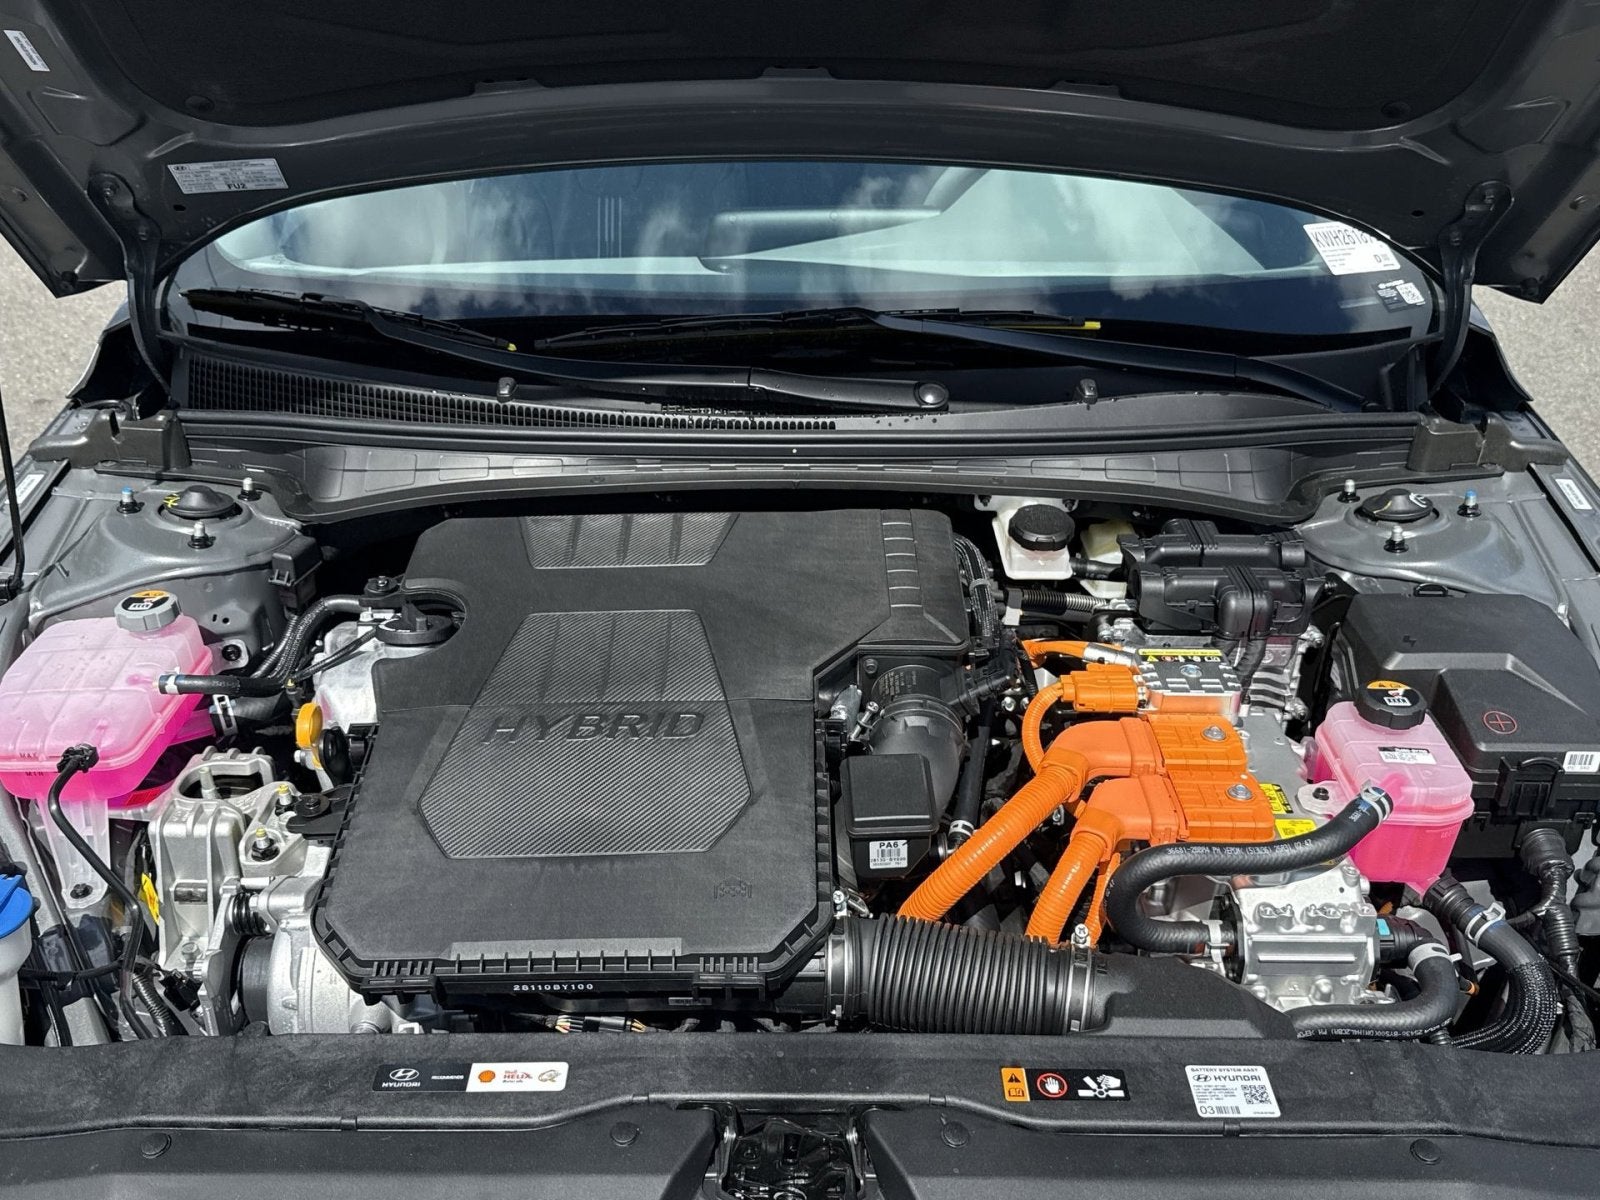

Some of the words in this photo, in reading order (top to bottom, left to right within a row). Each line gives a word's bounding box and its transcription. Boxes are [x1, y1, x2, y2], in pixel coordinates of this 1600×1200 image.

[482, 712, 705, 744] HYBRID
[513, 983, 594, 991] 28110BY100
[1200, 1105, 1216, 1115] 03
